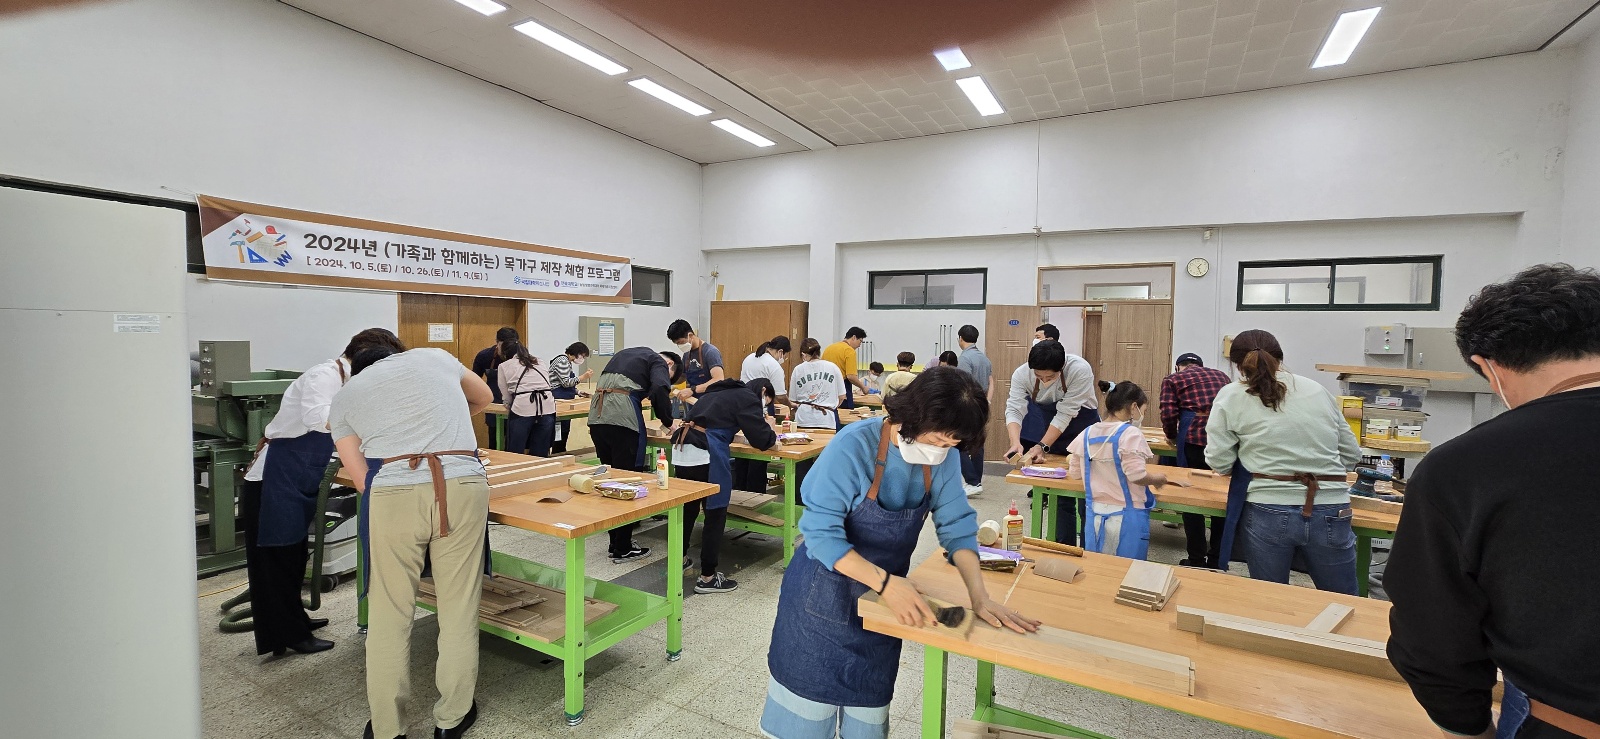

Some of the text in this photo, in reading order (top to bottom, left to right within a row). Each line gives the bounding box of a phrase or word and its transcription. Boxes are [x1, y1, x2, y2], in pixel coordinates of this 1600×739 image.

[303, 233, 621, 281] 2024년 (가족과 함께하는) 목가구 제작 체험 프로그램
[314, 258, 347, 269] 2024.
[350, 261, 365, 271] 10.
[367, 262, 392, 273] 5.(토)
[400, 266, 415, 275] 10.
[417, 267, 444, 278] 26.(토)
[452, 270, 462, 279] 11.
[464, 271, 483, 281] 9.(토)
[796, 372, 835, 388] SURFING
